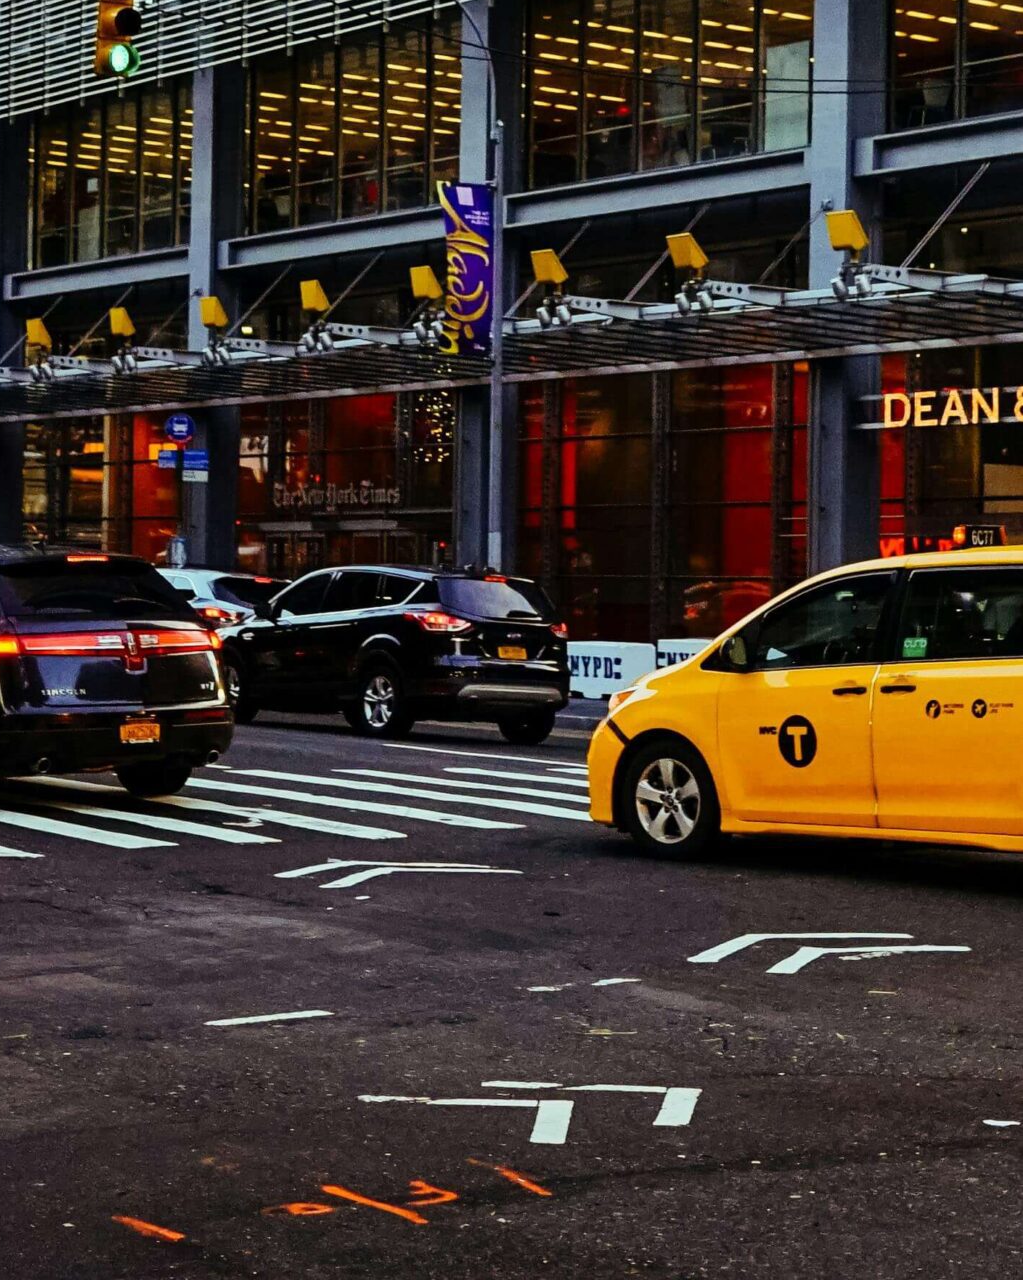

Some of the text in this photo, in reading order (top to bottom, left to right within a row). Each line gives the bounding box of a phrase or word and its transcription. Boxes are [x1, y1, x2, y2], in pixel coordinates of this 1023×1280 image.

[884, 387, 999, 428] DEAN
[273, 482, 294, 507] The
[326, 482, 357, 511] York
[359, 480, 400, 505] Times
[971, 530, 994, 546] 6C77
[570, 655, 613, 678] NYPD
